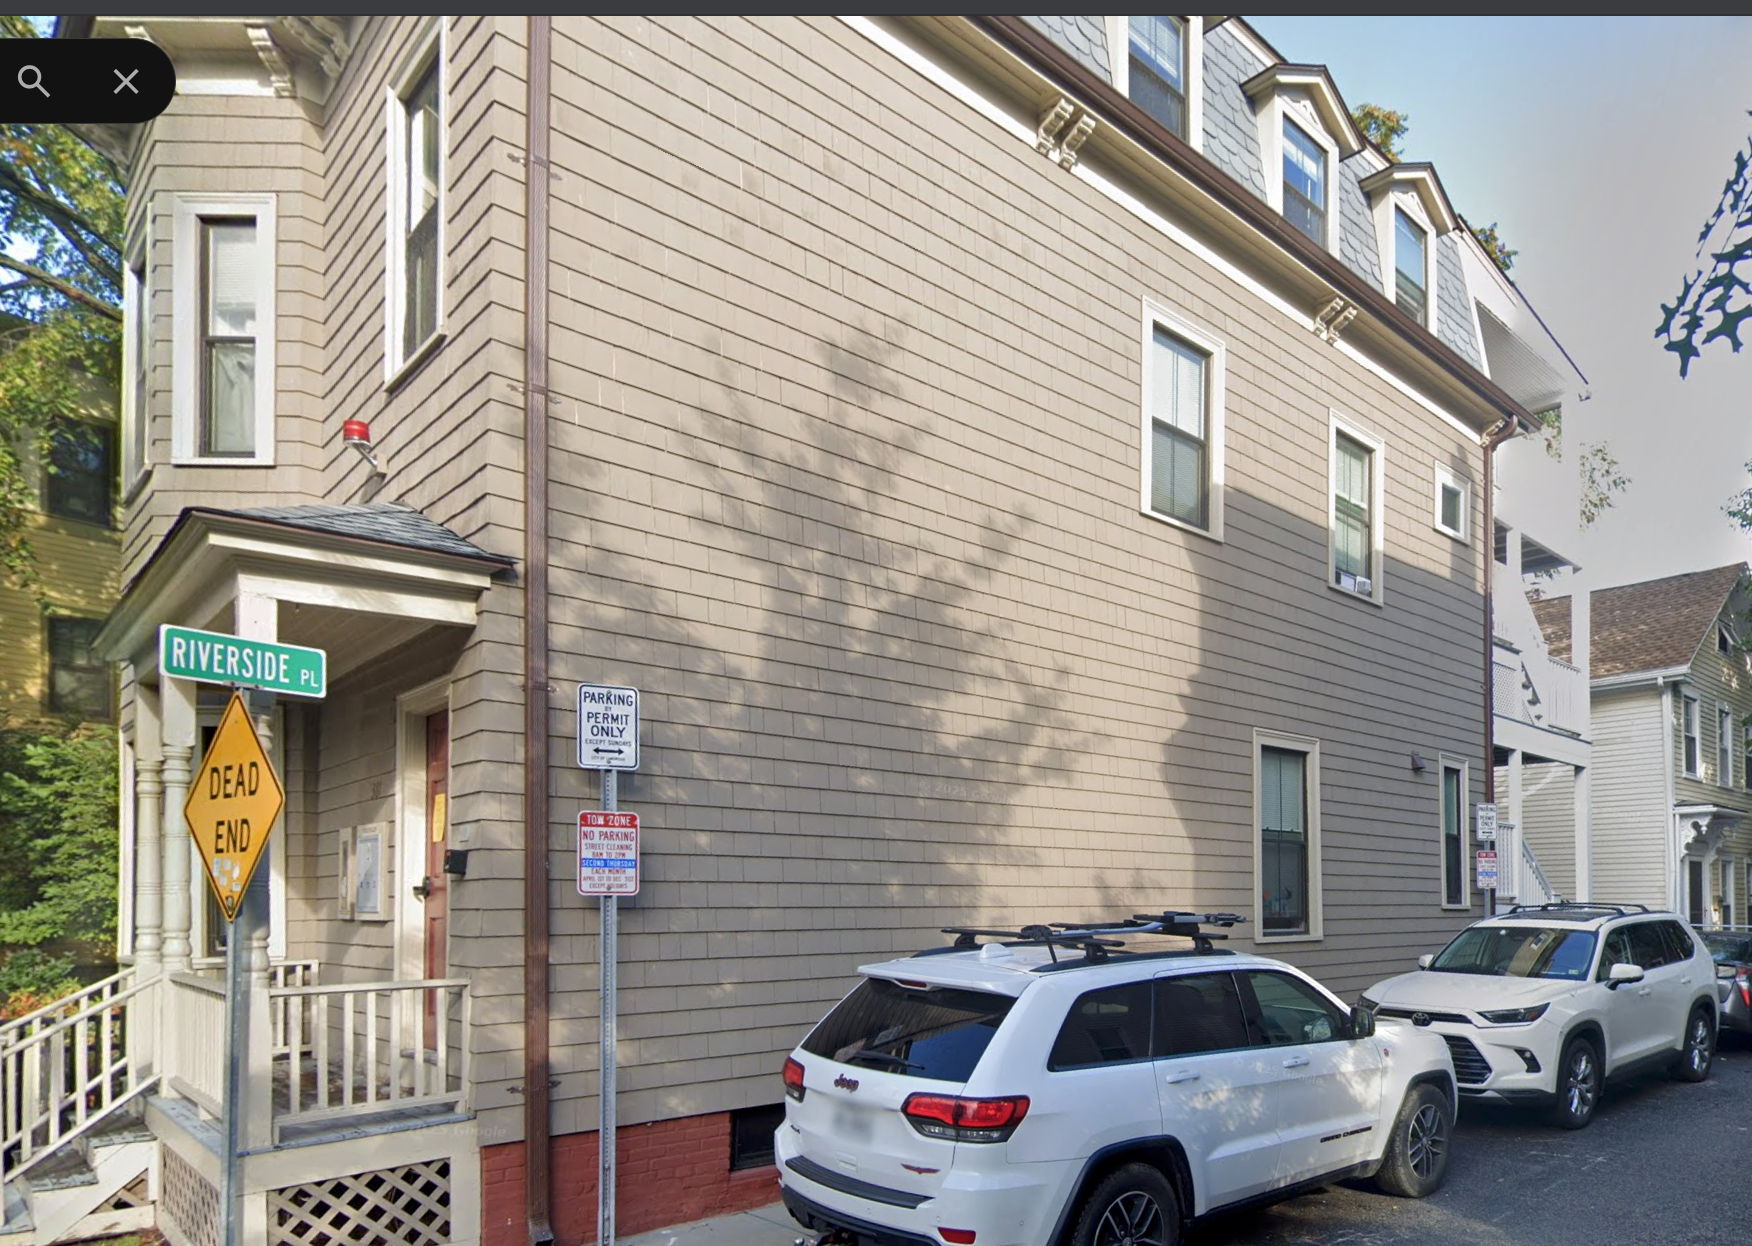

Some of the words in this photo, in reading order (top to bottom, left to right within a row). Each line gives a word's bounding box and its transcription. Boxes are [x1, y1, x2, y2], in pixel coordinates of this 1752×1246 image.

[172, 636, 290, 684] RIVERSIDE
[300, 668, 319, 688] PL
[583, 691, 634, 707] PARKING
[587, 711, 630, 725] PERMIT
[590, 724, 626, 738] ONLY
[584, 738, 606, 746] EXCEPT
[608, 739, 632, 747] SUNDAYS
[209, 761, 260, 801] DEAD
[587, 814, 604, 825] TOW
[607, 815, 632, 827] ZONE
[214, 818, 251, 854] END
[582, 829, 595, 841] NO
[598, 830, 635, 842] PARKING
[585, 843, 605, 851] STREET
[606, 843, 633, 851] CLEANING
[582, 859, 605, 867] SECOND
[606, 859, 636, 867] THURSDAY
[834, 1073, 859, 1093] Jeep
